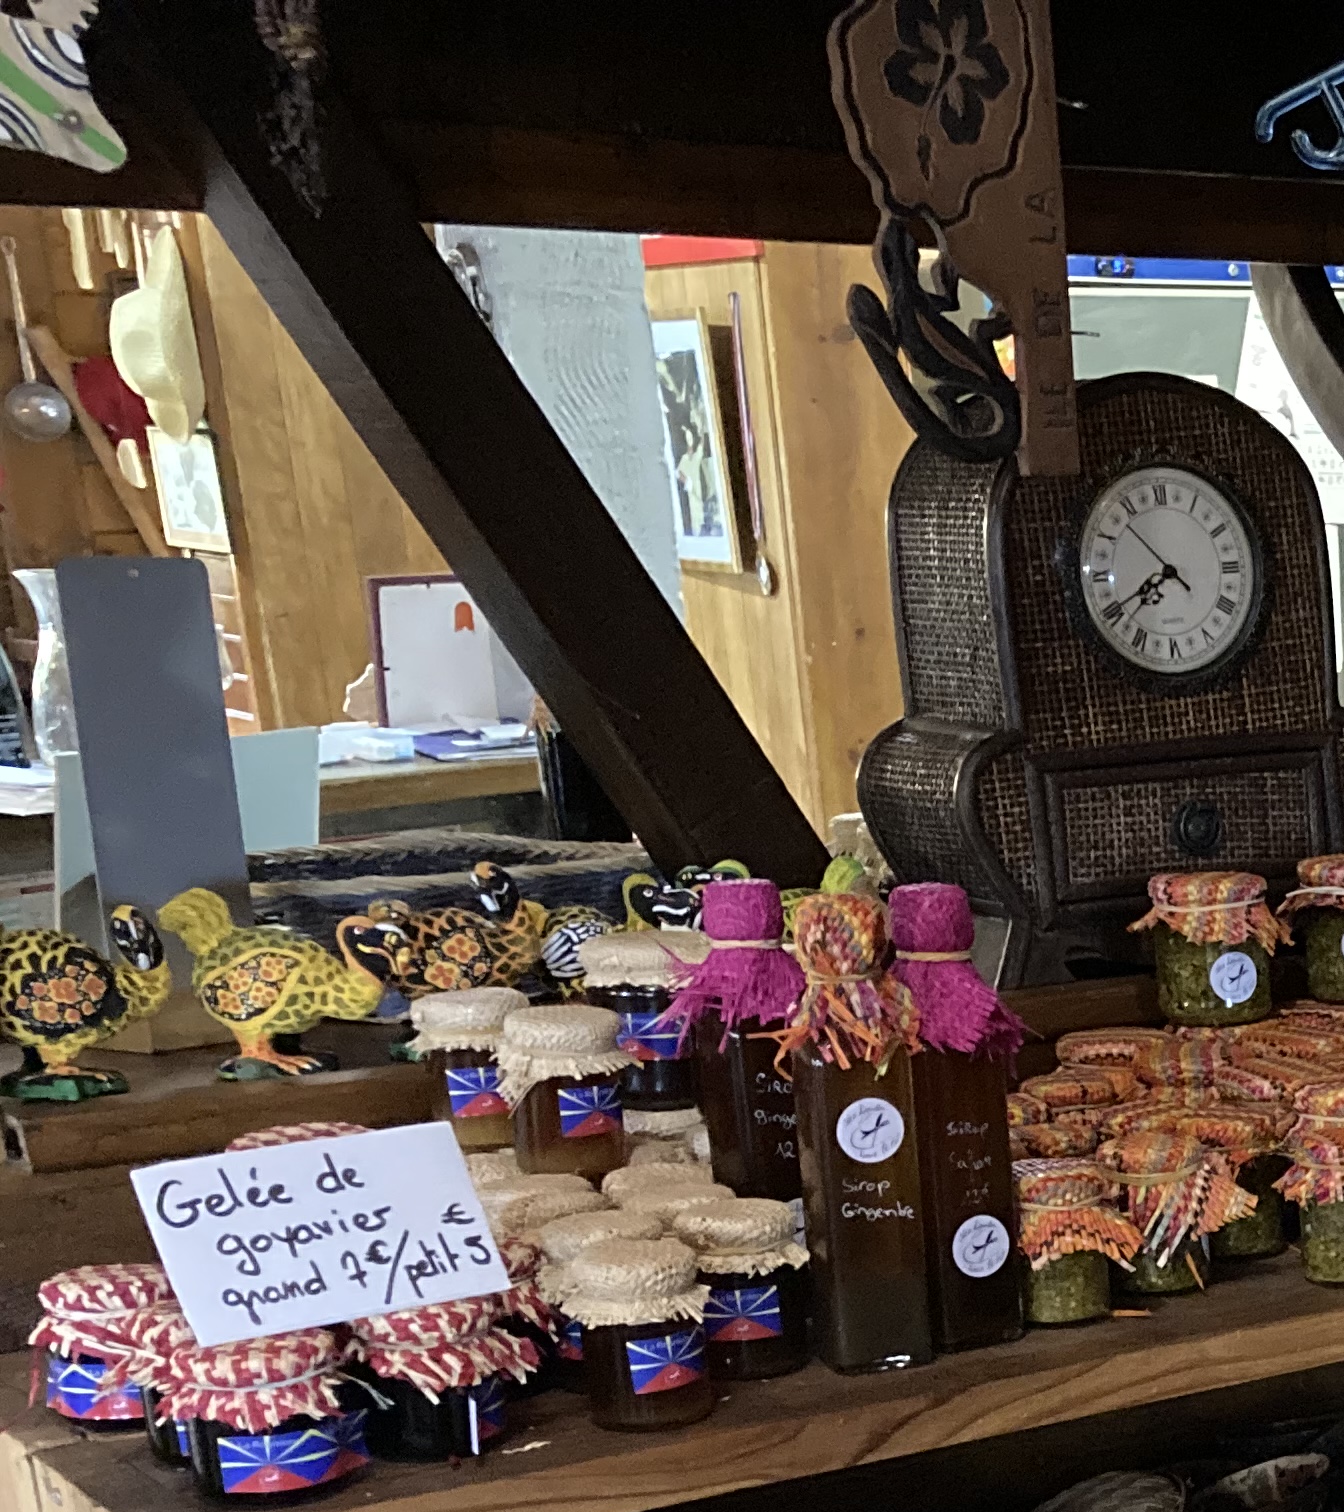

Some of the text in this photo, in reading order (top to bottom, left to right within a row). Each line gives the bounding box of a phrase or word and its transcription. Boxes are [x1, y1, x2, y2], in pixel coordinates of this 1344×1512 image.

[1024, 186, 1058, 244] LA
[156, 1153, 365, 1228] Gelée de
[216, 1206, 391, 1276] goyavier
[222, 1260, 327, 1325] grand
